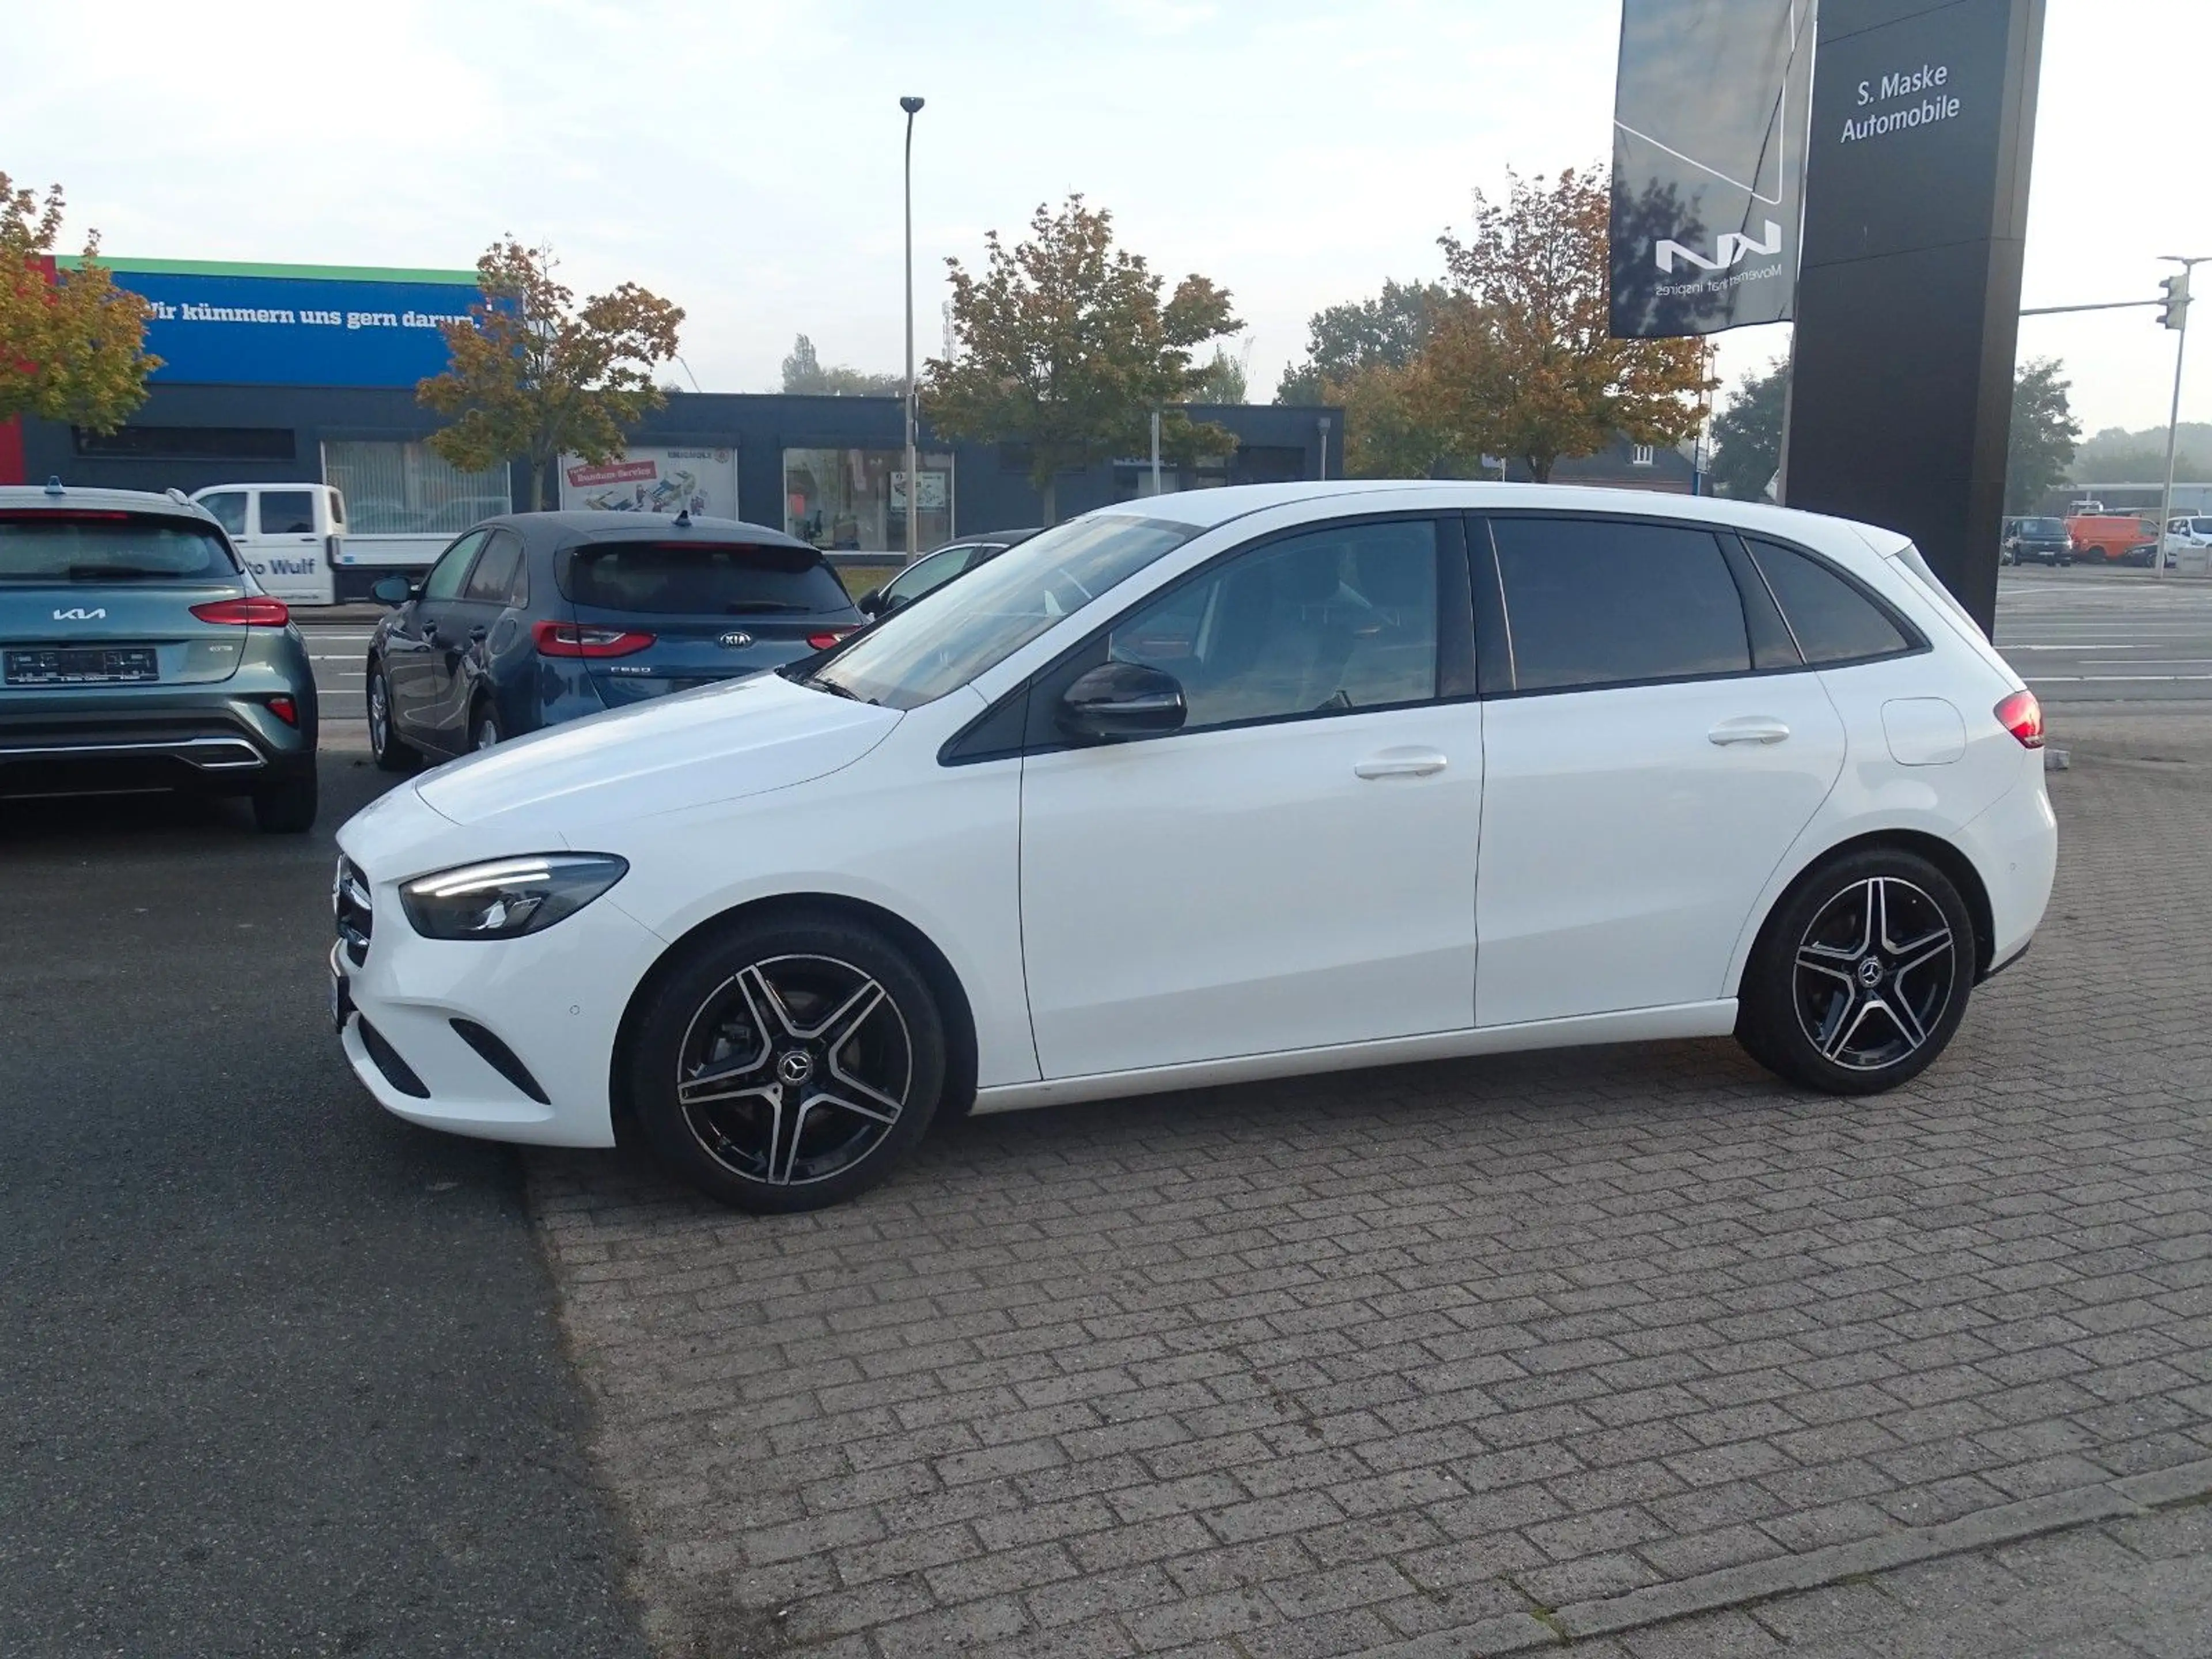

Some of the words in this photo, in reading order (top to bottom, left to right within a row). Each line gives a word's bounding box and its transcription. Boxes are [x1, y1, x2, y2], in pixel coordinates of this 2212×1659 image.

[1857, 81, 1874, 106] S.
[1880, 65, 1948, 100] Maske
[1840, 94, 1960, 143] Automobile
[181, 302, 296, 324] kümmern
[300, 310, 342, 325] uns
[347, 310, 397, 329] gern
[269, 558, 315, 575] Wulf
